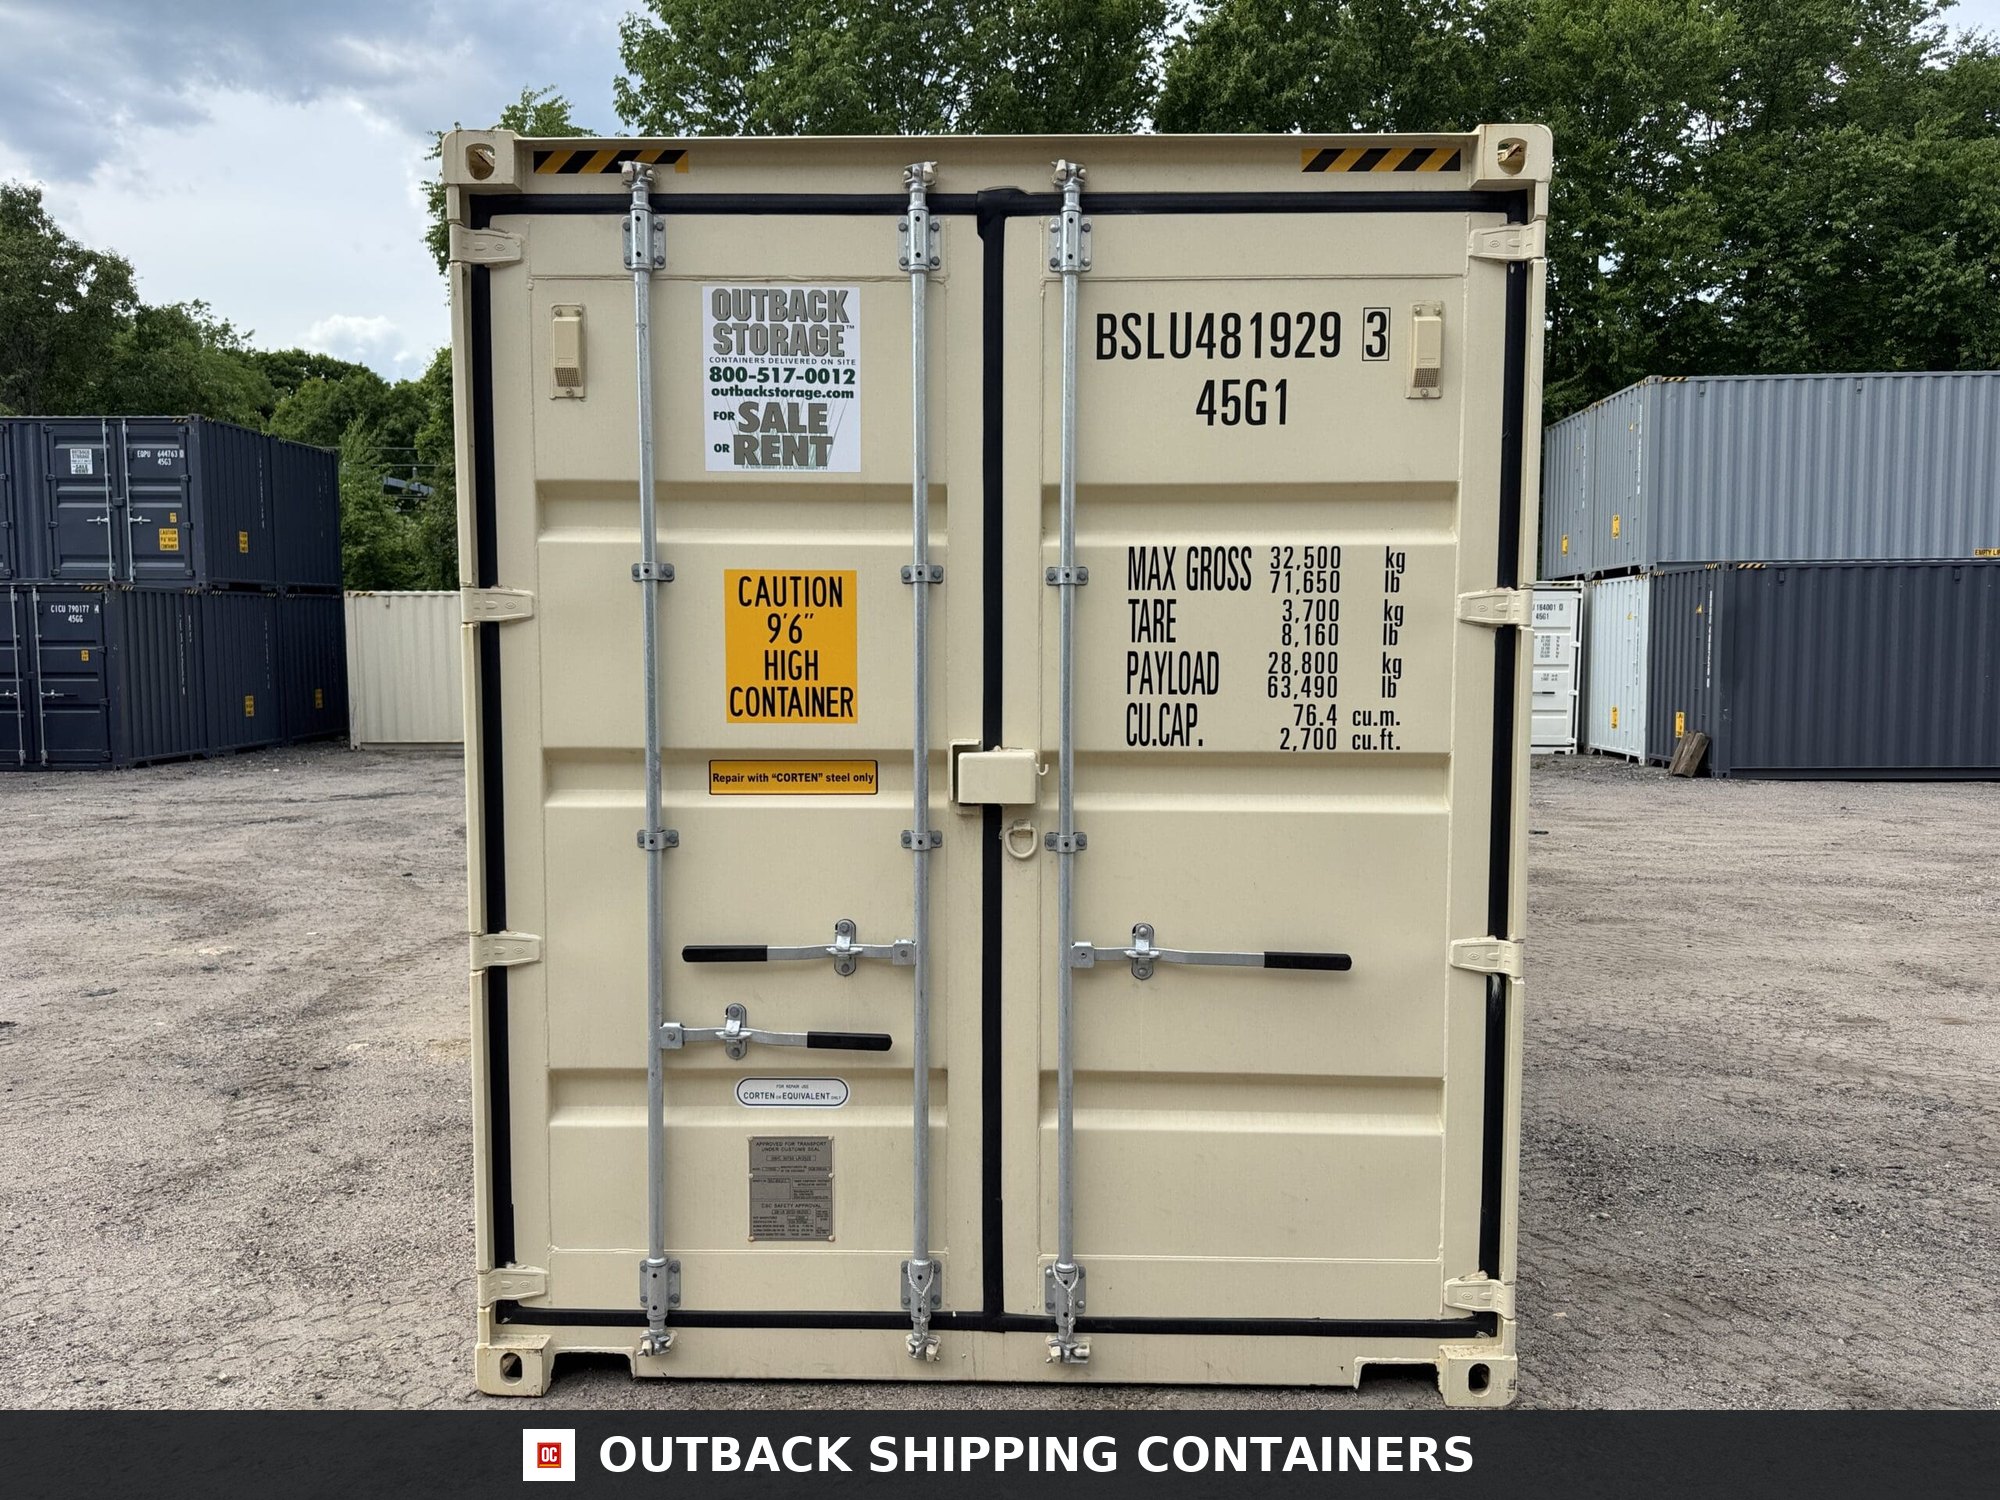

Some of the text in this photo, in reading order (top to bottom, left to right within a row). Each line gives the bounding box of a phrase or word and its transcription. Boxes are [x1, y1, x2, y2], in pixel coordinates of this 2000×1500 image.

[712, 288, 850, 323] OUTBACK
[1096, 311, 1387, 360] BSLU481929 3
[709, 366, 855, 384] 800-517-0012
[768, 357, 817, 365] DELIVERED
[711, 385, 854, 400] outbackstorage.com
[1196, 379, 1287, 426] 45G1
[713, 401, 828, 434] FOR SALE
[714, 434, 833, 467] OR RENT
[1128, 546, 1405, 591] MAX GROSS 32,500 kg
[1270, 570, 1400, 595] 71,650 lb
[738, 576, 843, 607] CAUTION
[1128, 599, 1404, 643] TARE 3,700 kg
[1282, 623, 1398, 647] 8,160 lb
[764, 650, 819, 681] HIGH
[1127, 651, 1402, 695] PAYLOAD 28,800 kg
[730, 686, 854, 718] CONTAINER
[1268, 676, 1397, 700] 63,490 lb
[1126, 703, 1400, 747] CU.CAP. 76.4 cu.m.
[1279, 728, 1401, 752] 2,700 cu.ft.
[712, 773, 744, 784] Repair
[747, 773, 769, 782] with
[825, 773, 850, 782] steel
[853, 773, 874, 784] only
[782, 1092, 830, 1100] EQUIVALENT
